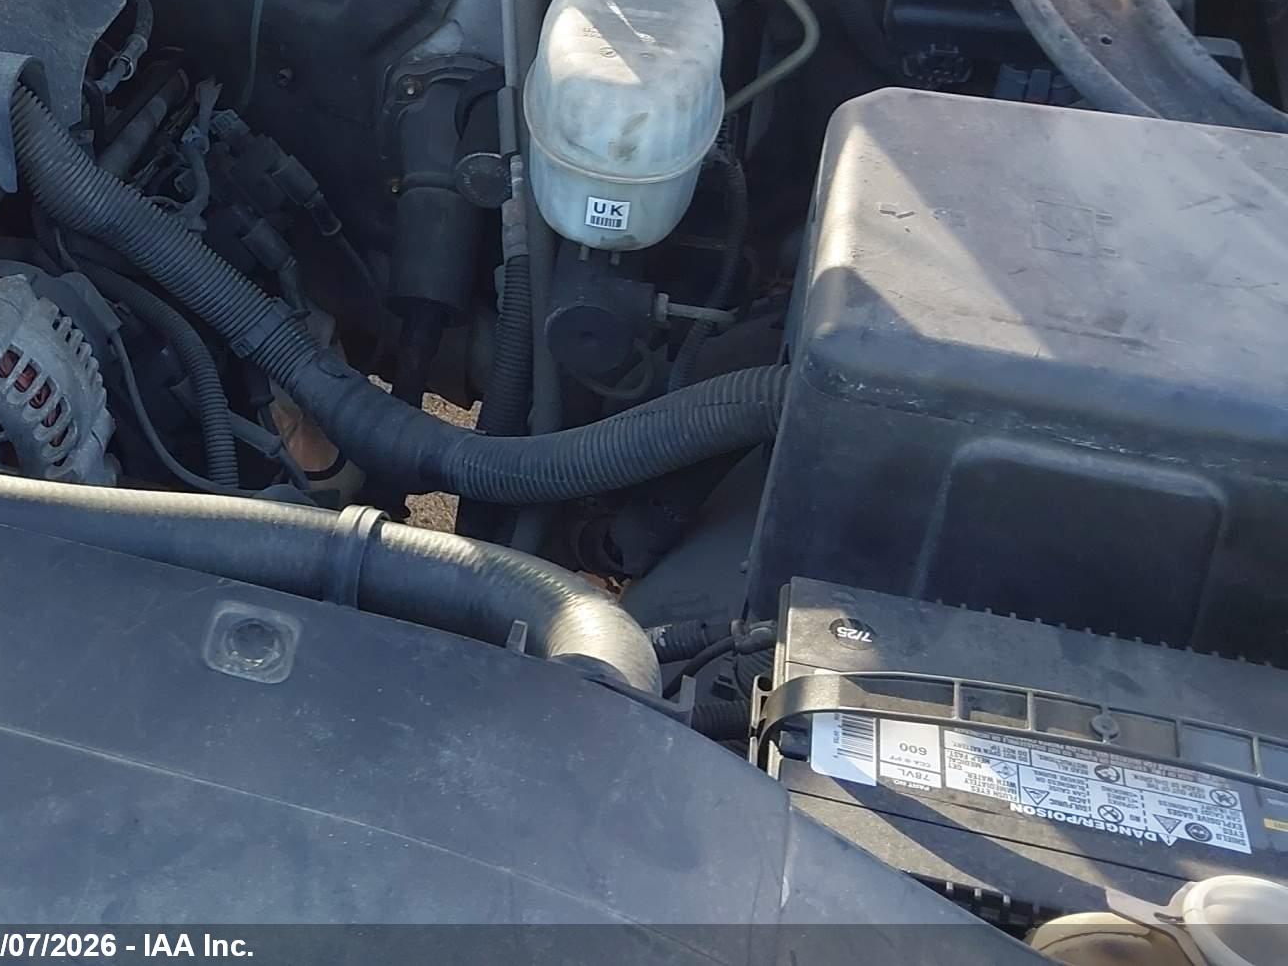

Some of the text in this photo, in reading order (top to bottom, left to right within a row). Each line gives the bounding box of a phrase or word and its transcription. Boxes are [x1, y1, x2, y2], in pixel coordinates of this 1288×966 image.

[837, 626, 872, 642] 7/25
[899, 742, 928, 756] 600
[914, 760, 931, 769] CCA
[946, 756, 982, 769] MEDICAL
[970, 755, 990, 764] HELP
[948, 763, 962, 771] GET
[897, 768, 930, 780] 78VL
[908, 781, 931, 791] PART
[964, 778, 1017, 794] IMMEDIATELY
[996, 779, 1017, 787] WITH
[993, 791, 1017, 801] FLUSH
[1068, 796, 1086, 804] ACID
[1048, 799, 1088, 812] SULFURIC
[1010, 802, 1158, 842] DANGER/POISON
[1167, 809, 1242, 829] EXPLOSIVE GASES
